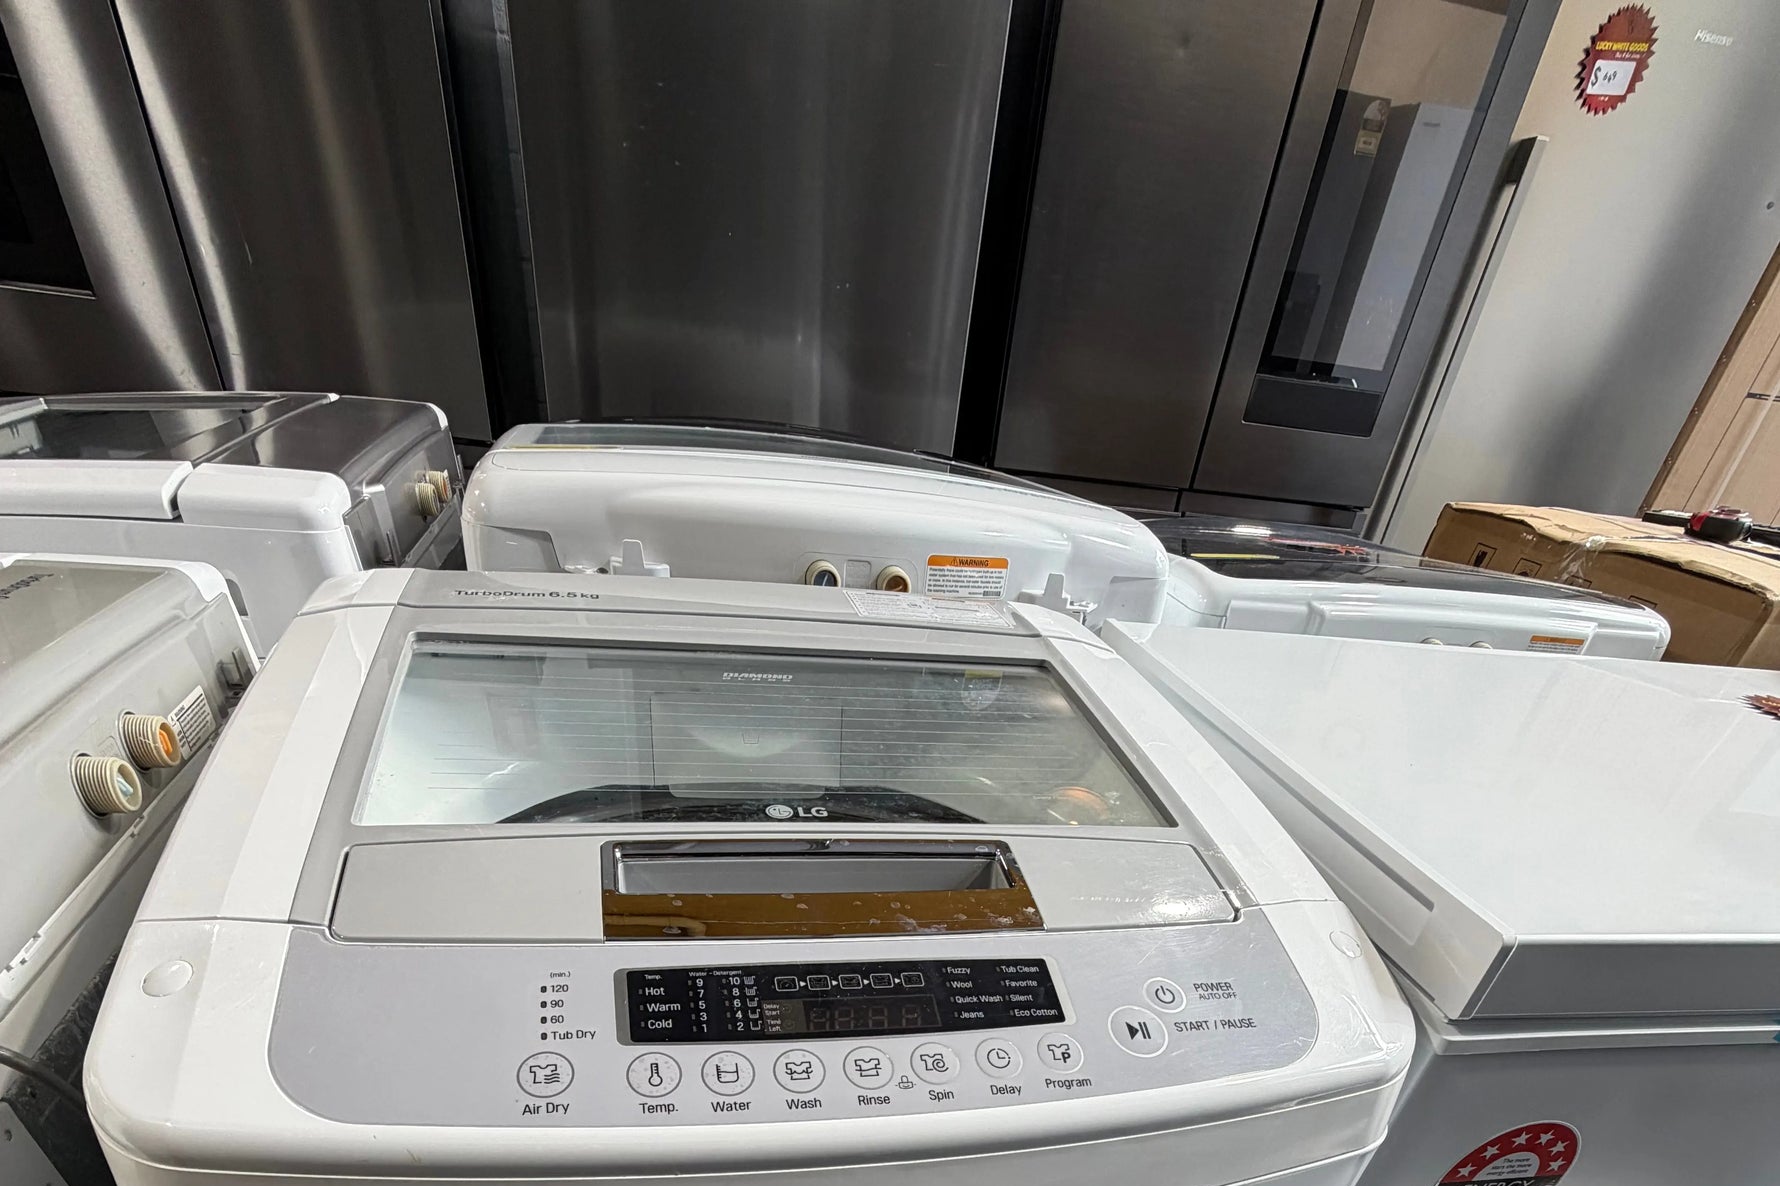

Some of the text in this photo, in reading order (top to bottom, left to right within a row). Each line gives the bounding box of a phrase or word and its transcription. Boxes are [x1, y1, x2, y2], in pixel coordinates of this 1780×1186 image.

[958, 558, 989, 567] WARNING
[454, 589, 600, 600] TurboDrum 6.5 kg
[797, 806, 828, 818] LG
[947, 966, 971, 975] Fuzzy
[1001, 965, 1039, 973] Tub Clean
[696, 978, 704, 987] 9
[729, 977, 741, 985] 10
[1005, 979, 1038, 987] Favorite
[550, 984, 569, 993] 120
[645, 987, 665, 996] Hot
[1193, 981, 1234, 993] POWER
[698, 989, 705, 998] 7
[732, 988, 740, 997] 8
[1198, 991, 1237, 1001] AUTO OFF
[955, 995, 978, 1003] Quick
[1010, 994, 1034, 1002] Silent
[550, 999, 564, 1009] 90
[646, 1002, 681, 1012] Warm
[698, 1001, 706, 1010] 5
[733, 999, 741, 1008] 6
[700, 1012, 708, 1021] 3
[735, 1011, 743, 1020] 4
[960, 1010, 985, 1019] Jeans
[1014, 1008, 1059, 1017] Eco Cotton
[550, 1015, 564, 1024] 60
[647, 1019, 673, 1029] Cold
[701, 1024, 708, 1033] 1
[737, 1022, 745, 1031] 2
[1174, 1019, 1210, 1032] START
[1220, 1017, 1257, 1030] PAUSE
[550, 1029, 596, 1040] Tub Dry
[1045, 1076, 1092, 1090] Program
[928, 1088, 955, 1102] Spin
[990, 1084, 1022, 1097] Delay
[786, 1097, 822, 1111] Wash
[857, 1094, 891, 1107] Rinse
[522, 1102, 570, 1116] Air Dry
[639, 1102, 679, 1116] Temp.
[711, 1101, 752, 1113] Water
